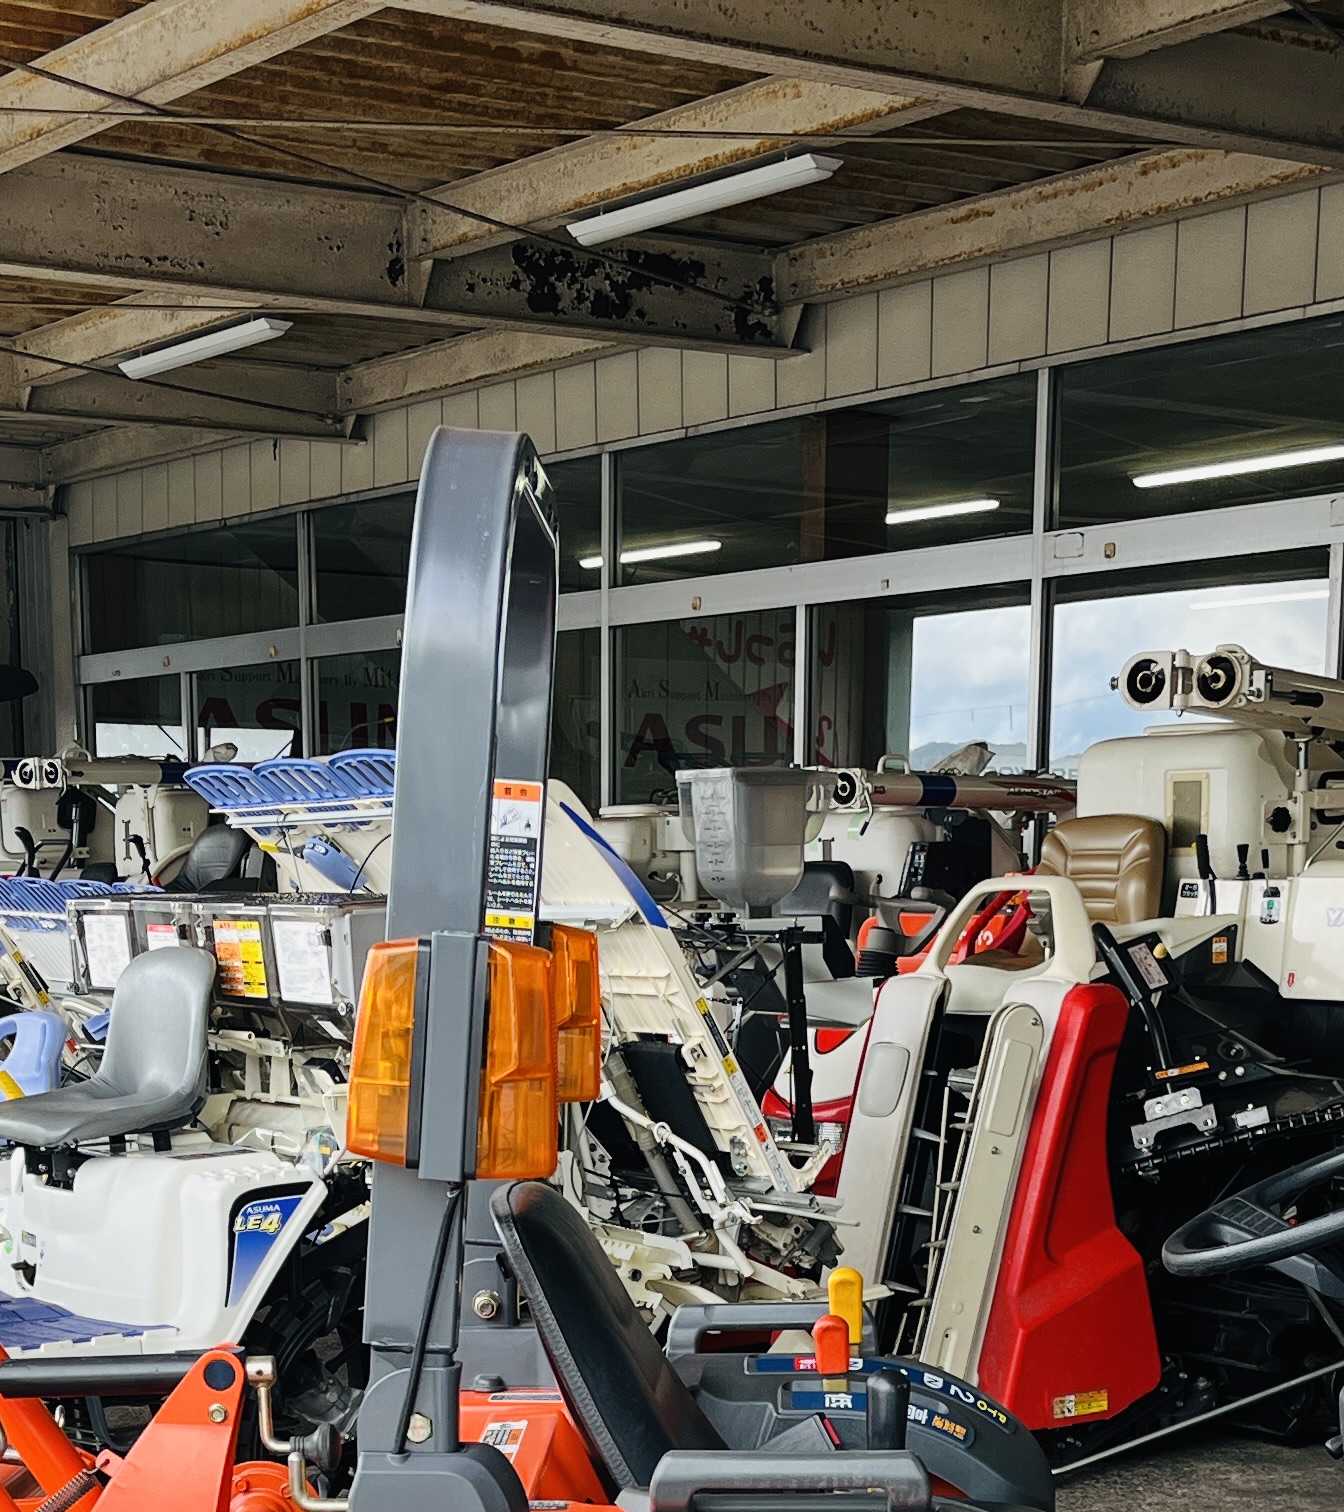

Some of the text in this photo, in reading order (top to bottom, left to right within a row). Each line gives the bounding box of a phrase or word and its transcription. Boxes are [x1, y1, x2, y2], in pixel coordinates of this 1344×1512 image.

[246, 1204, 280, 1214] ASUMA
[233, 1213, 282, 1235] LE4
[976, 1400, 1007, 1425] PTO
